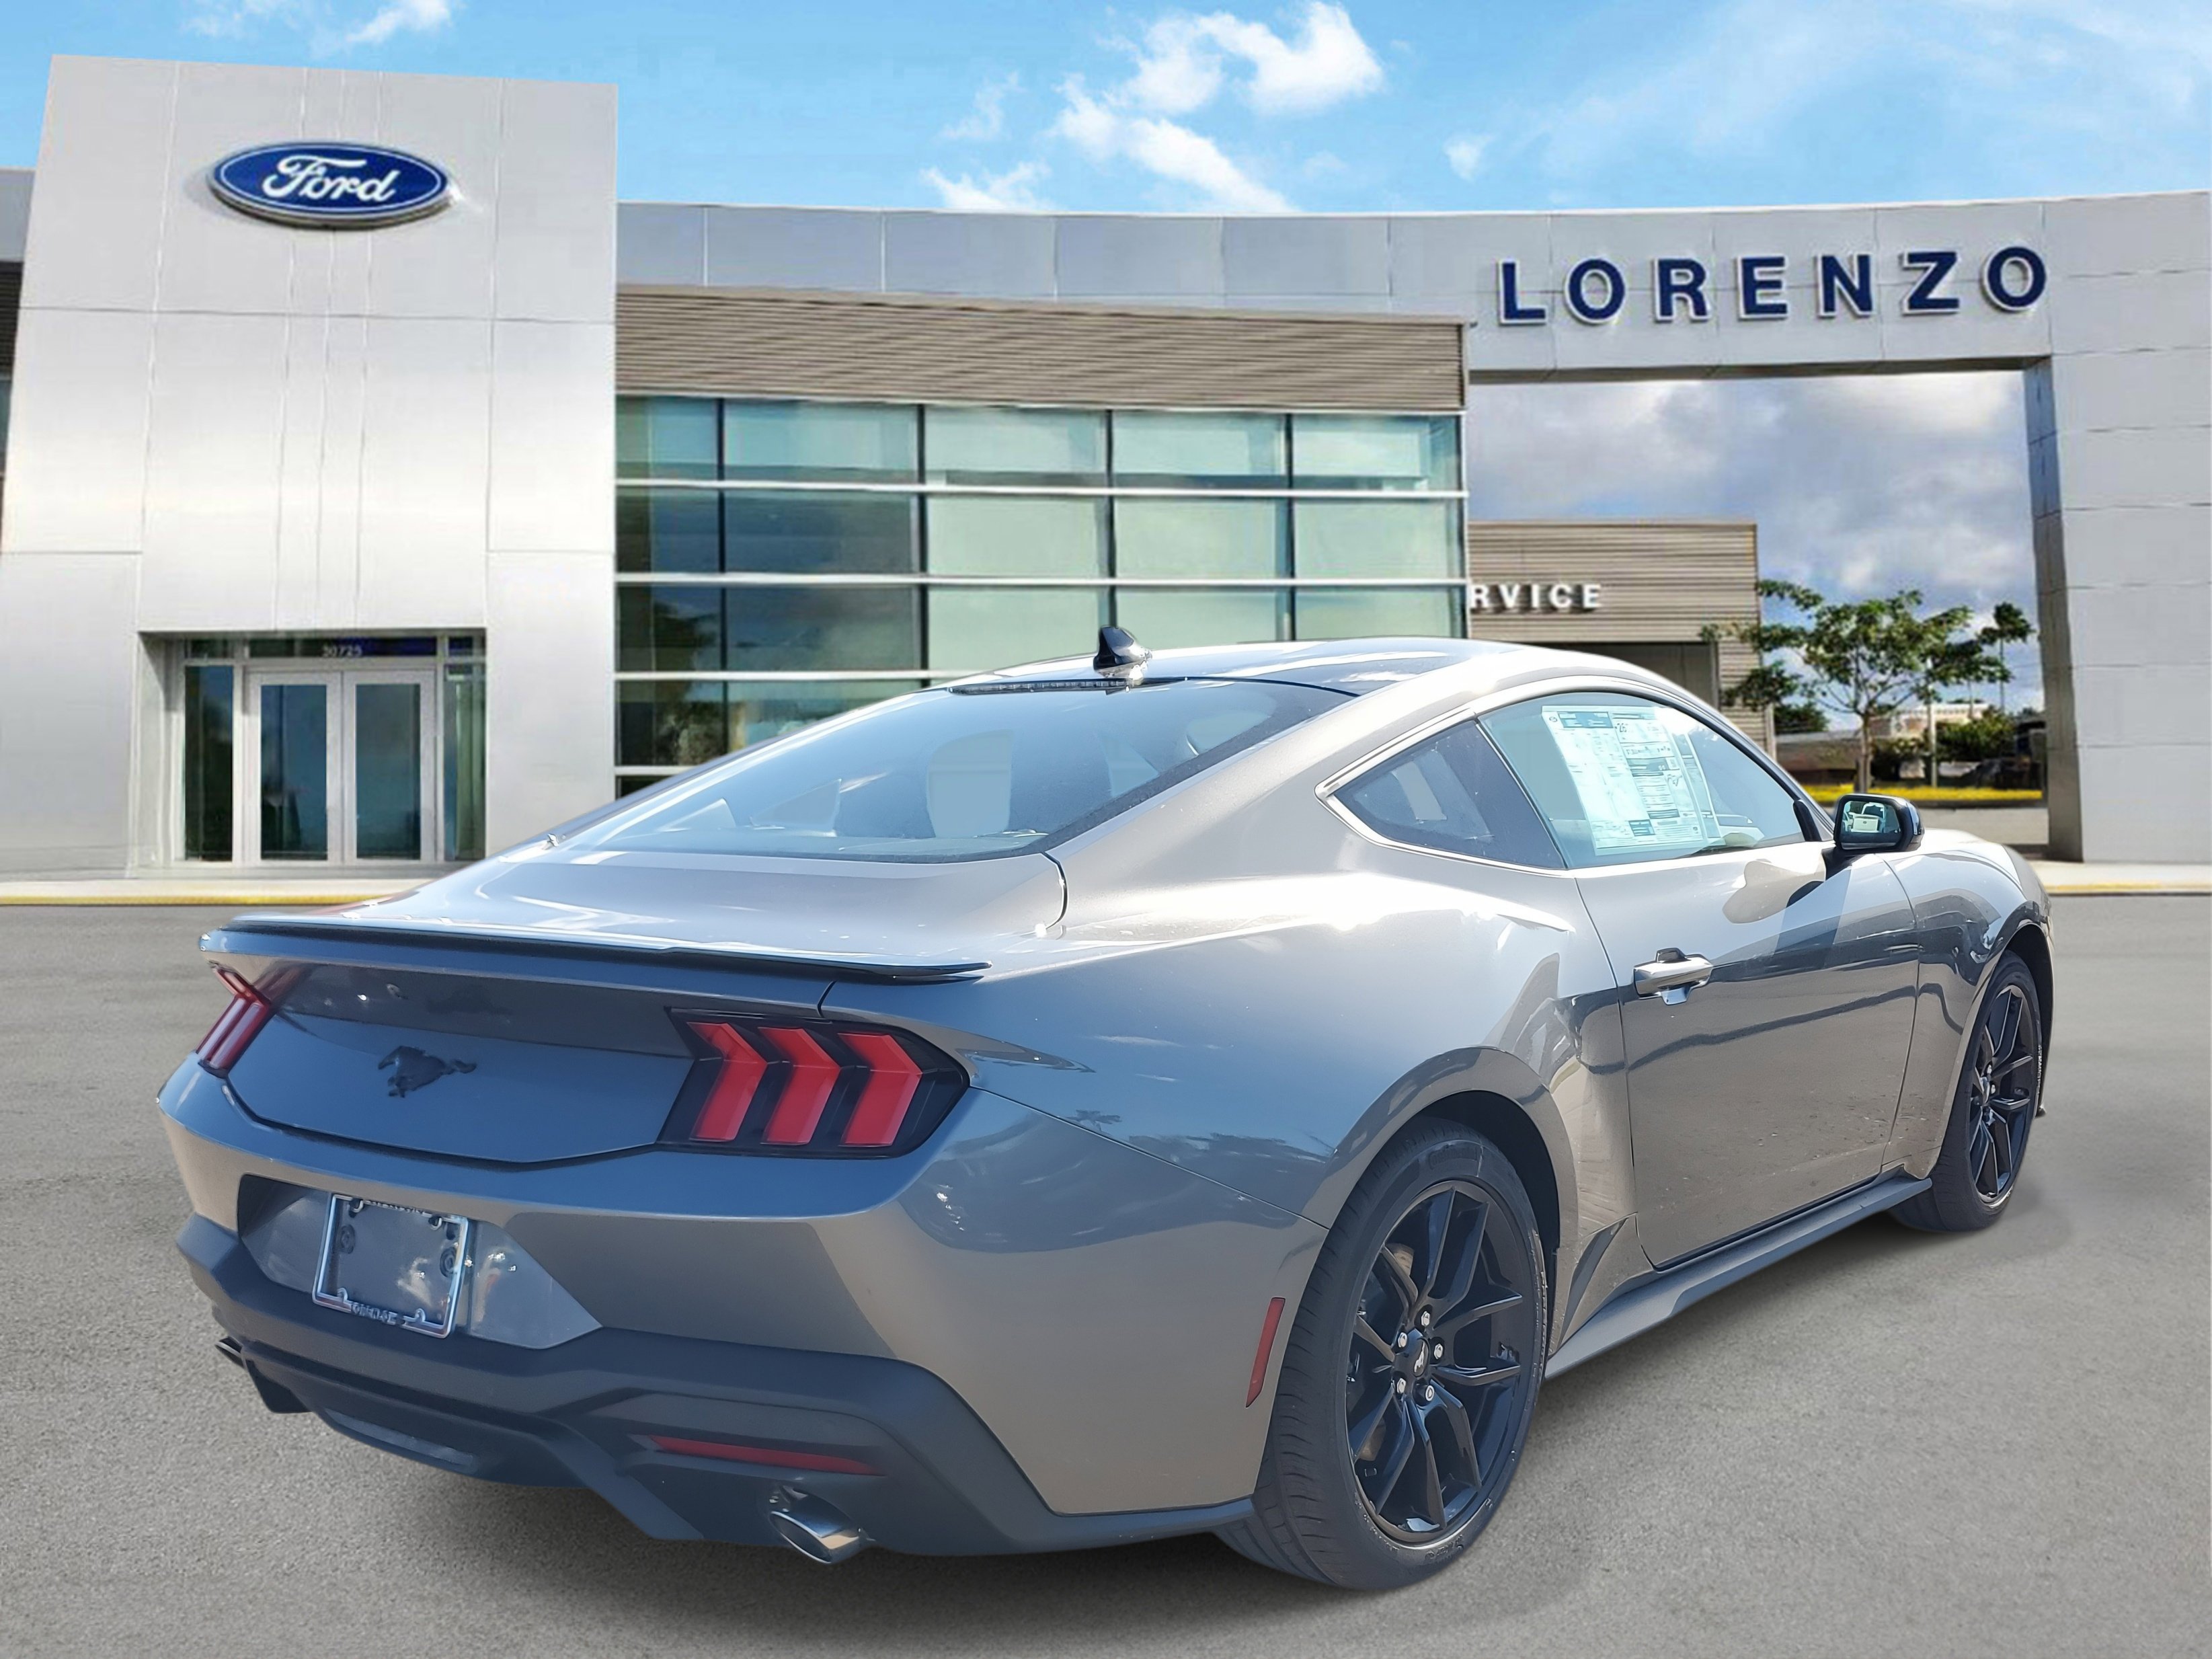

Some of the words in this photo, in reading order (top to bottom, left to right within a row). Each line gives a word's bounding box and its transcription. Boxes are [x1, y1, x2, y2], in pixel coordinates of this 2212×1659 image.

[262, 154, 400, 202] Ford
[1498, 247, 2047, 325] LORENZO
[1470, 583, 1604, 609] RVICE
